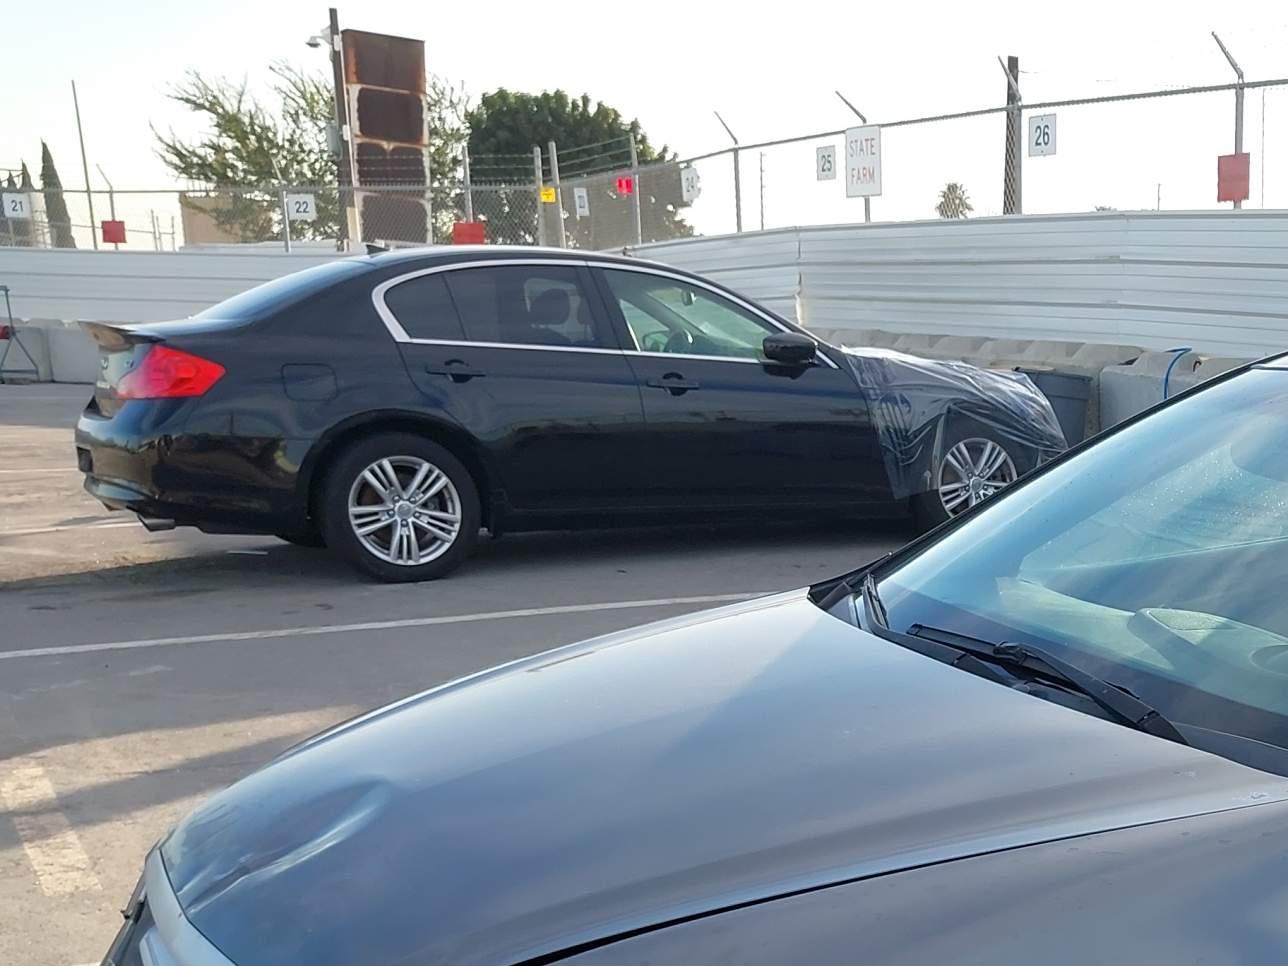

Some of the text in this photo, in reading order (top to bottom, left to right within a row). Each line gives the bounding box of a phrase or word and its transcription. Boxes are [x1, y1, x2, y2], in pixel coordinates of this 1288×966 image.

[1035, 125, 1050, 146] 26
[849, 137, 876, 158] STATE
[821, 154, 833, 172] 25
[851, 166, 875, 185] FARM
[11, 200, 24, 212] 21
[295, 201, 310, 213] 22
